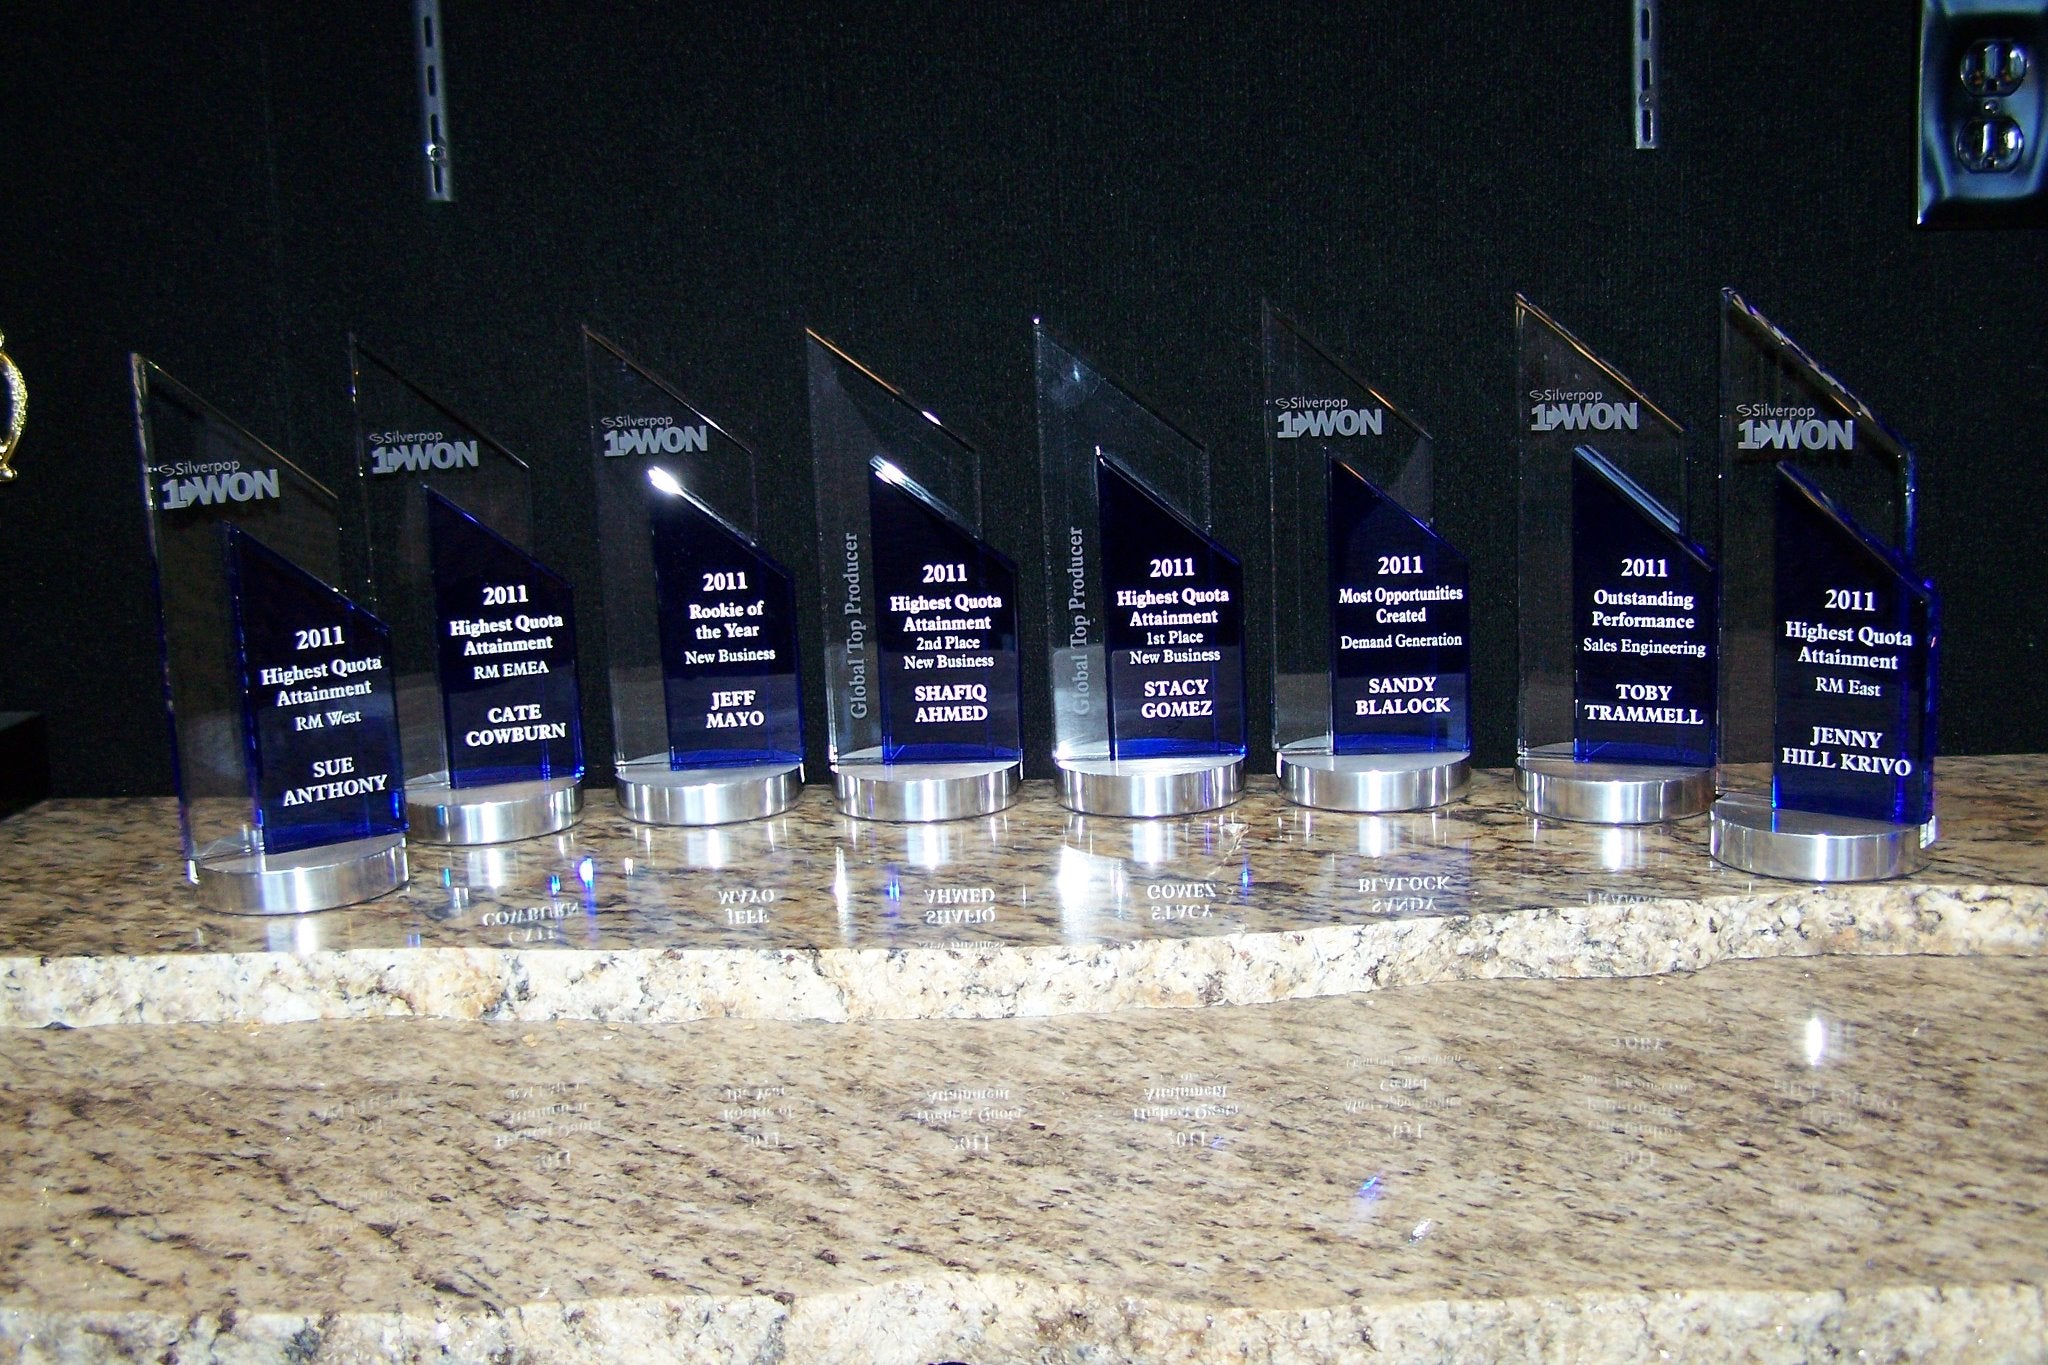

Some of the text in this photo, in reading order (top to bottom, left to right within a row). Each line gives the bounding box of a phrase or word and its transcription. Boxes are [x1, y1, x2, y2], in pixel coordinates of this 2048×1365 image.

[1291, 396, 1348, 411] Silverpop
[1545, 388, 1603, 403] Silverpop
[616, 414, 673, 428] Silverpop
[1752, 403, 1816, 419] Silverpop
[384, 430, 444, 445] Silverpop
[176, 459, 240, 476] Silverpop
[922, 563, 968, 584] 2011
[1149, 557, 1195, 578] 2011
[1377, 555, 1424, 575] 2011
[1620, 558, 1668, 578] 2011
[702, 571, 748, 592] 2011
[482, 584, 529, 606] 2011
[889, 593, 1003, 615] Highest Quota
[1116, 587, 1230, 609] Highest Quota
[1338, 584, 1464, 606] Most Opportunities
[1593, 589, 1694, 611] Outstanding
[1824, 588, 1876, 612] 2011
[688, 599, 765, 620] Rookie of
[1129, 609, 1219, 627] Attainment
[1375, 606, 1427, 624] Created
[1591, 610, 1695, 629] Performance
[449, 614, 564, 638] Highest Quota
[695, 622, 760, 640] the Year
[843, 532, 868, 719] Global Top Producer
[902, 615, 992, 633] Attainment
[1067, 526, 1090, 715] Global Top Producer
[295, 625, 345, 650] 2011
[916, 635, 981, 651] 2nd Place
[1146, 630, 1204, 646] 1st Place
[1340, 632, 1463, 650] Demand Generation
[1785, 620, 1913, 647] Highest Quota
[463, 635, 554, 657] Attainment
[684, 647, 776, 665] New Business
[1129, 647, 1221, 665] New Business
[1583, 637, 1706, 659] Sales Engineering
[903, 653, 995, 670] New Business
[1797, 646, 1899, 670] Attainment
[260, 656, 383, 686] Highest Quota
[473, 660, 550, 680] RM EMEA
[276, 680, 373, 707] Attainment
[914, 683, 988, 703] SHAFIQ
[1144, 678, 1209, 698] STACY
[1368, 676, 1437, 694] SANDY
[1615, 683, 1673, 702] TOBY
[1815, 676, 1881, 697] RM East
[710, 689, 756, 711] JEFF
[1141, 699, 1213, 719] GOMEZ
[1355, 696, 1451, 716] BLALOCK
[294, 710, 362, 732] RM West
[487, 703, 543, 724] CATE
[705, 710, 765, 729] MAYO
[914, 705, 989, 723] AHMED
[1583, 704, 1704, 725] TRAMMELL
[465, 722, 567, 747] COWBURN
[1809, 726, 1883, 749] JENNY
[312, 756, 355, 778] SUE
[1781, 747, 1912, 777] HILL KRIVO
[283, 773, 388, 807] ANTHONY
